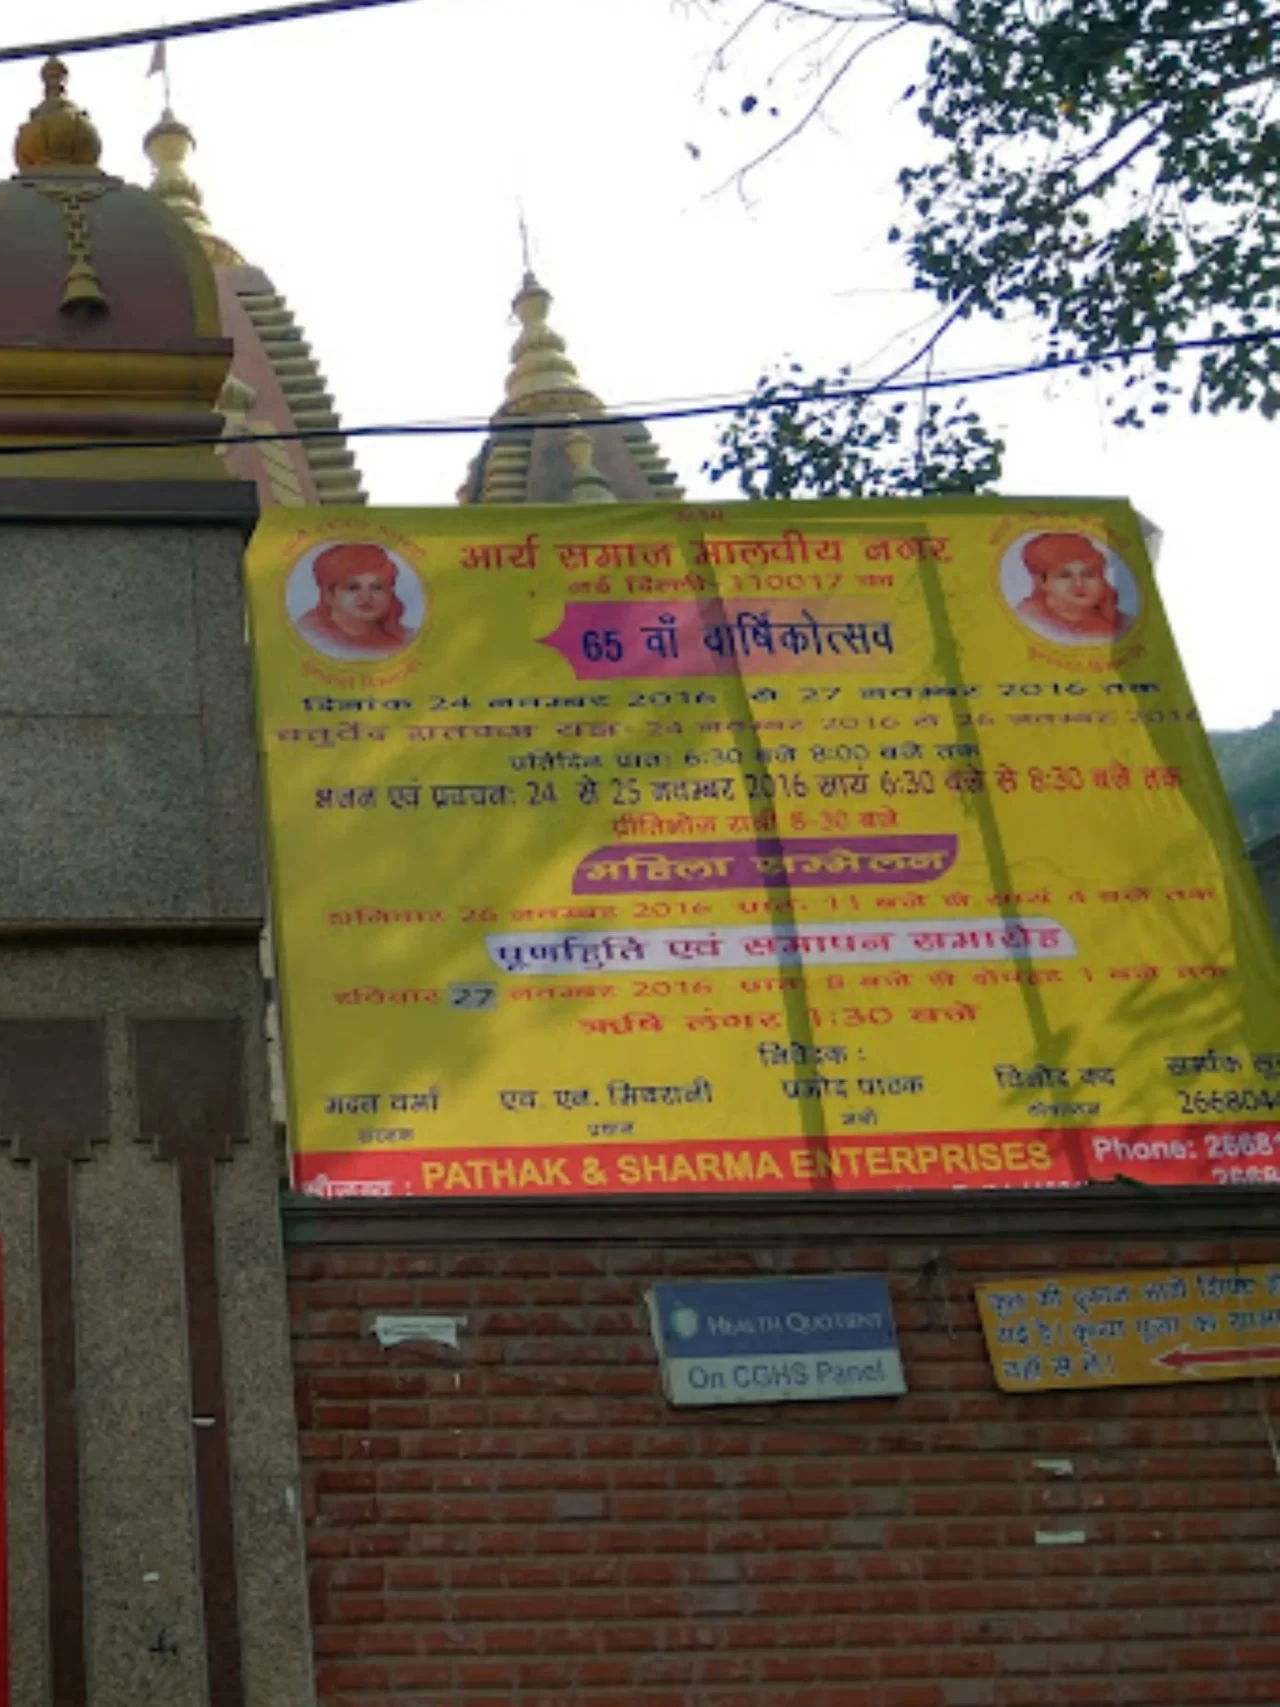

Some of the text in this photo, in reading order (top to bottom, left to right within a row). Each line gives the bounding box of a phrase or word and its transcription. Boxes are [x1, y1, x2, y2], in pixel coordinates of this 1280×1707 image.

[459, 534, 540, 570] आर्य
[554, 543, 675, 570] समाज
[690, 528, 845, 566] मालवीय
[859, 536, 952, 563] नगर
[581, 629, 624, 661] 65
[430, 695, 472, 711] 24
[627, 690, 718, 708] 2016
[798, 687, 841, 703] 27
[997, 681, 1088, 697] 2016
[610, 777, 641, 806] 25
[745, 771, 809, 800] 2016
[585, 853, 736, 882] महिला
[632, 901, 712, 919] 2016
[665, 931, 723, 960] एवं
[741, 932, 896, 958] समापन
[908, 924, 1063, 951] समारोह
[451, 986, 496, 1008] 27
[631, 979, 714, 998] 2016
[1091, 1135, 1198, 1162] Phone:
[421, 1156, 571, 1190] PATHAK
[582, 1156, 608, 1186] &
[618, 1149, 784, 1186] SHARMA
[793, 1140, 1053, 1179] ENTERPRISES
[687, 1358, 886, 1390] On CGHS Panel
